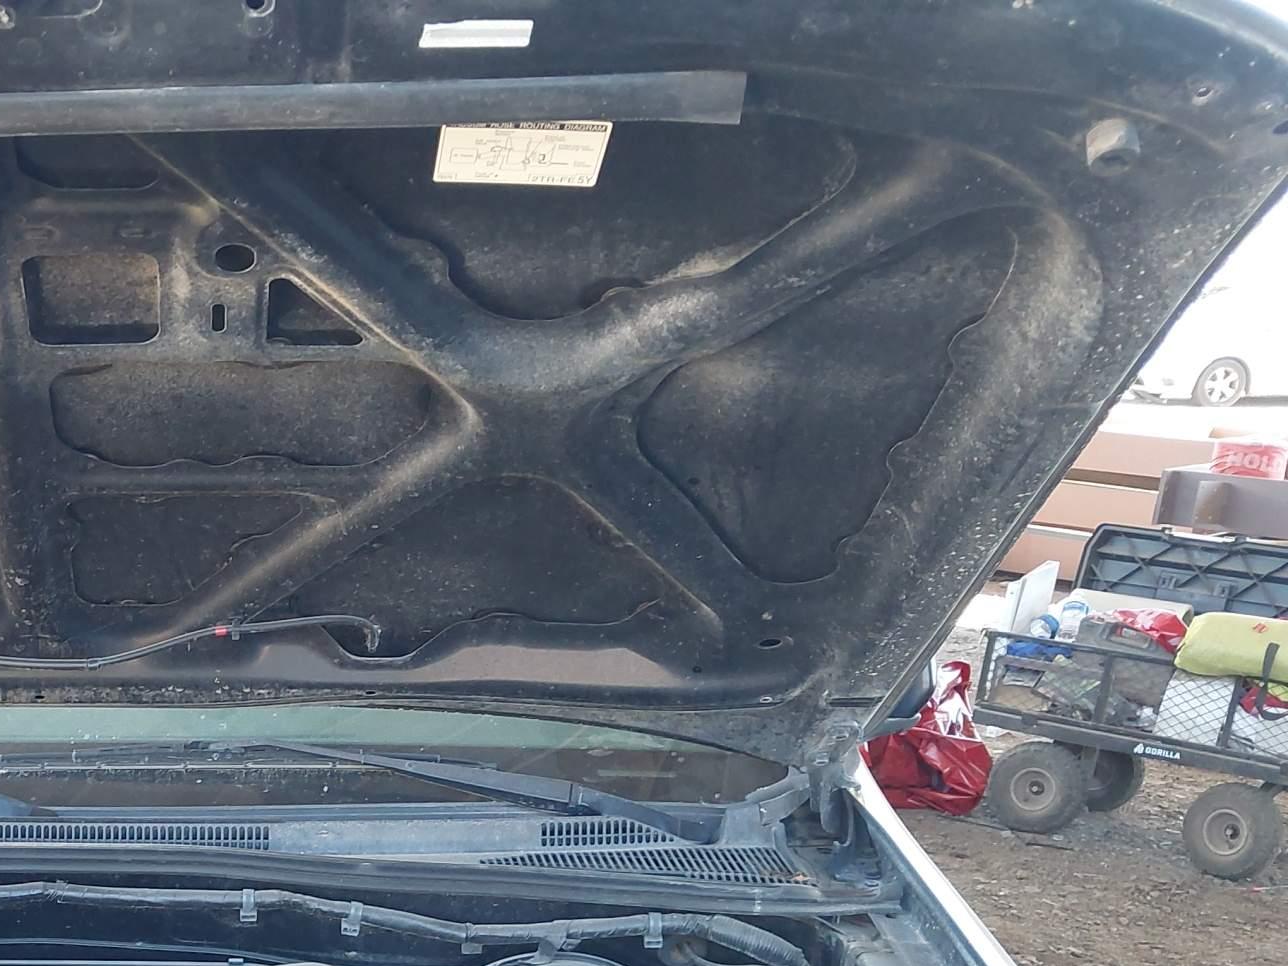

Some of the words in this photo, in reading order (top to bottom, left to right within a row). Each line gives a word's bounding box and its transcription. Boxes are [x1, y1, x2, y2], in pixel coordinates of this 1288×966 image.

[520, 122, 560, 130] ROUTING
[564, 124, 606, 132] DIAGRAM
[1145, 747, 1181, 759] GORILLA
